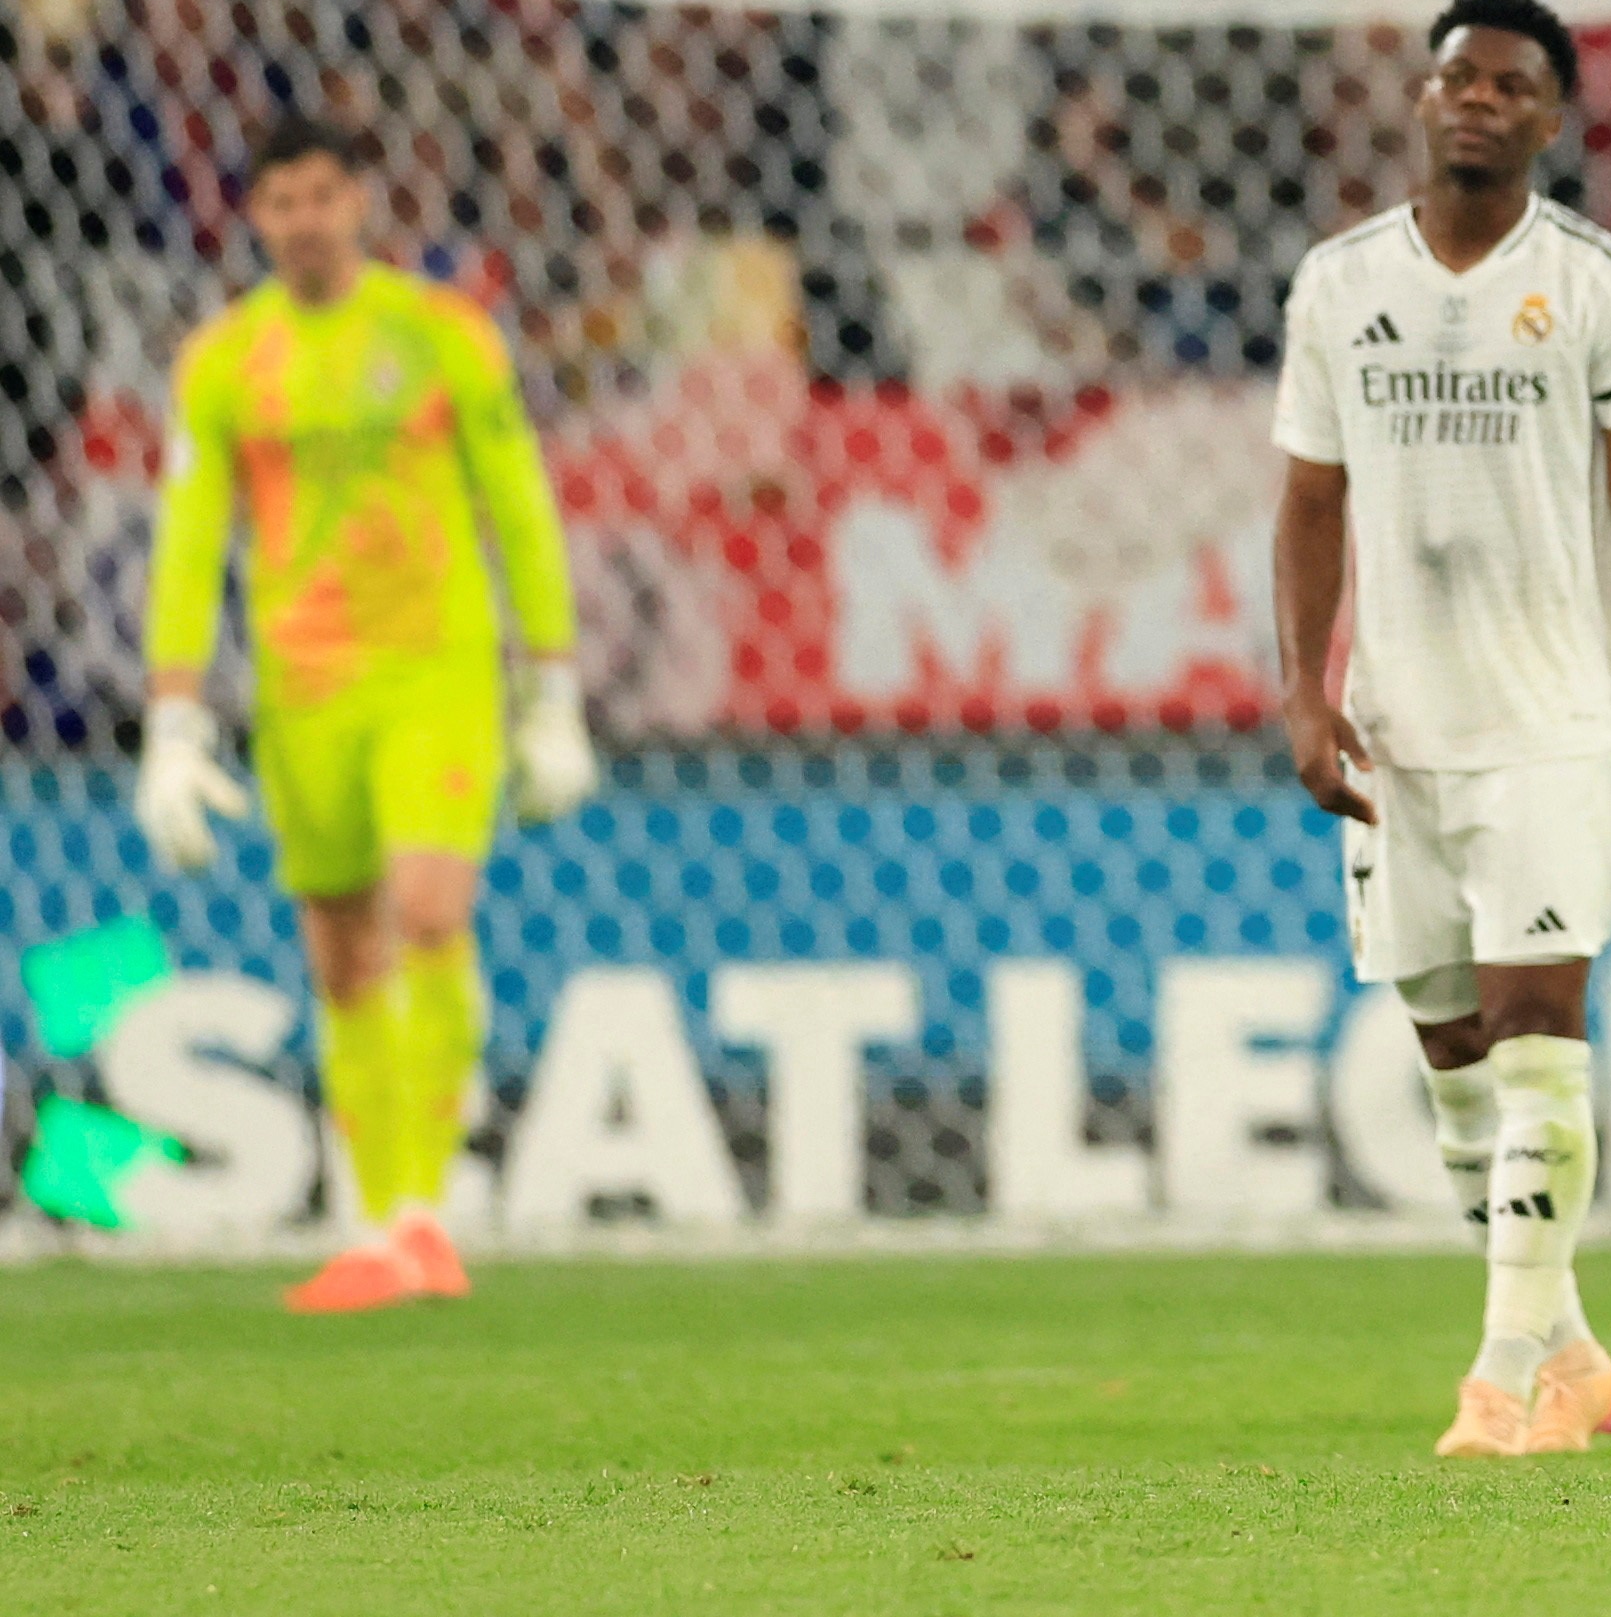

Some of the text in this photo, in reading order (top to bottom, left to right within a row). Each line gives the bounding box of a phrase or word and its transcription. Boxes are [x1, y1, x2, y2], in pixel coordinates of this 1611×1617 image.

[1360, 359, 1549, 408] Emirates
[1436, 408, 1520, 445] BETTER
[100, 964, 920, 1232] SAT
